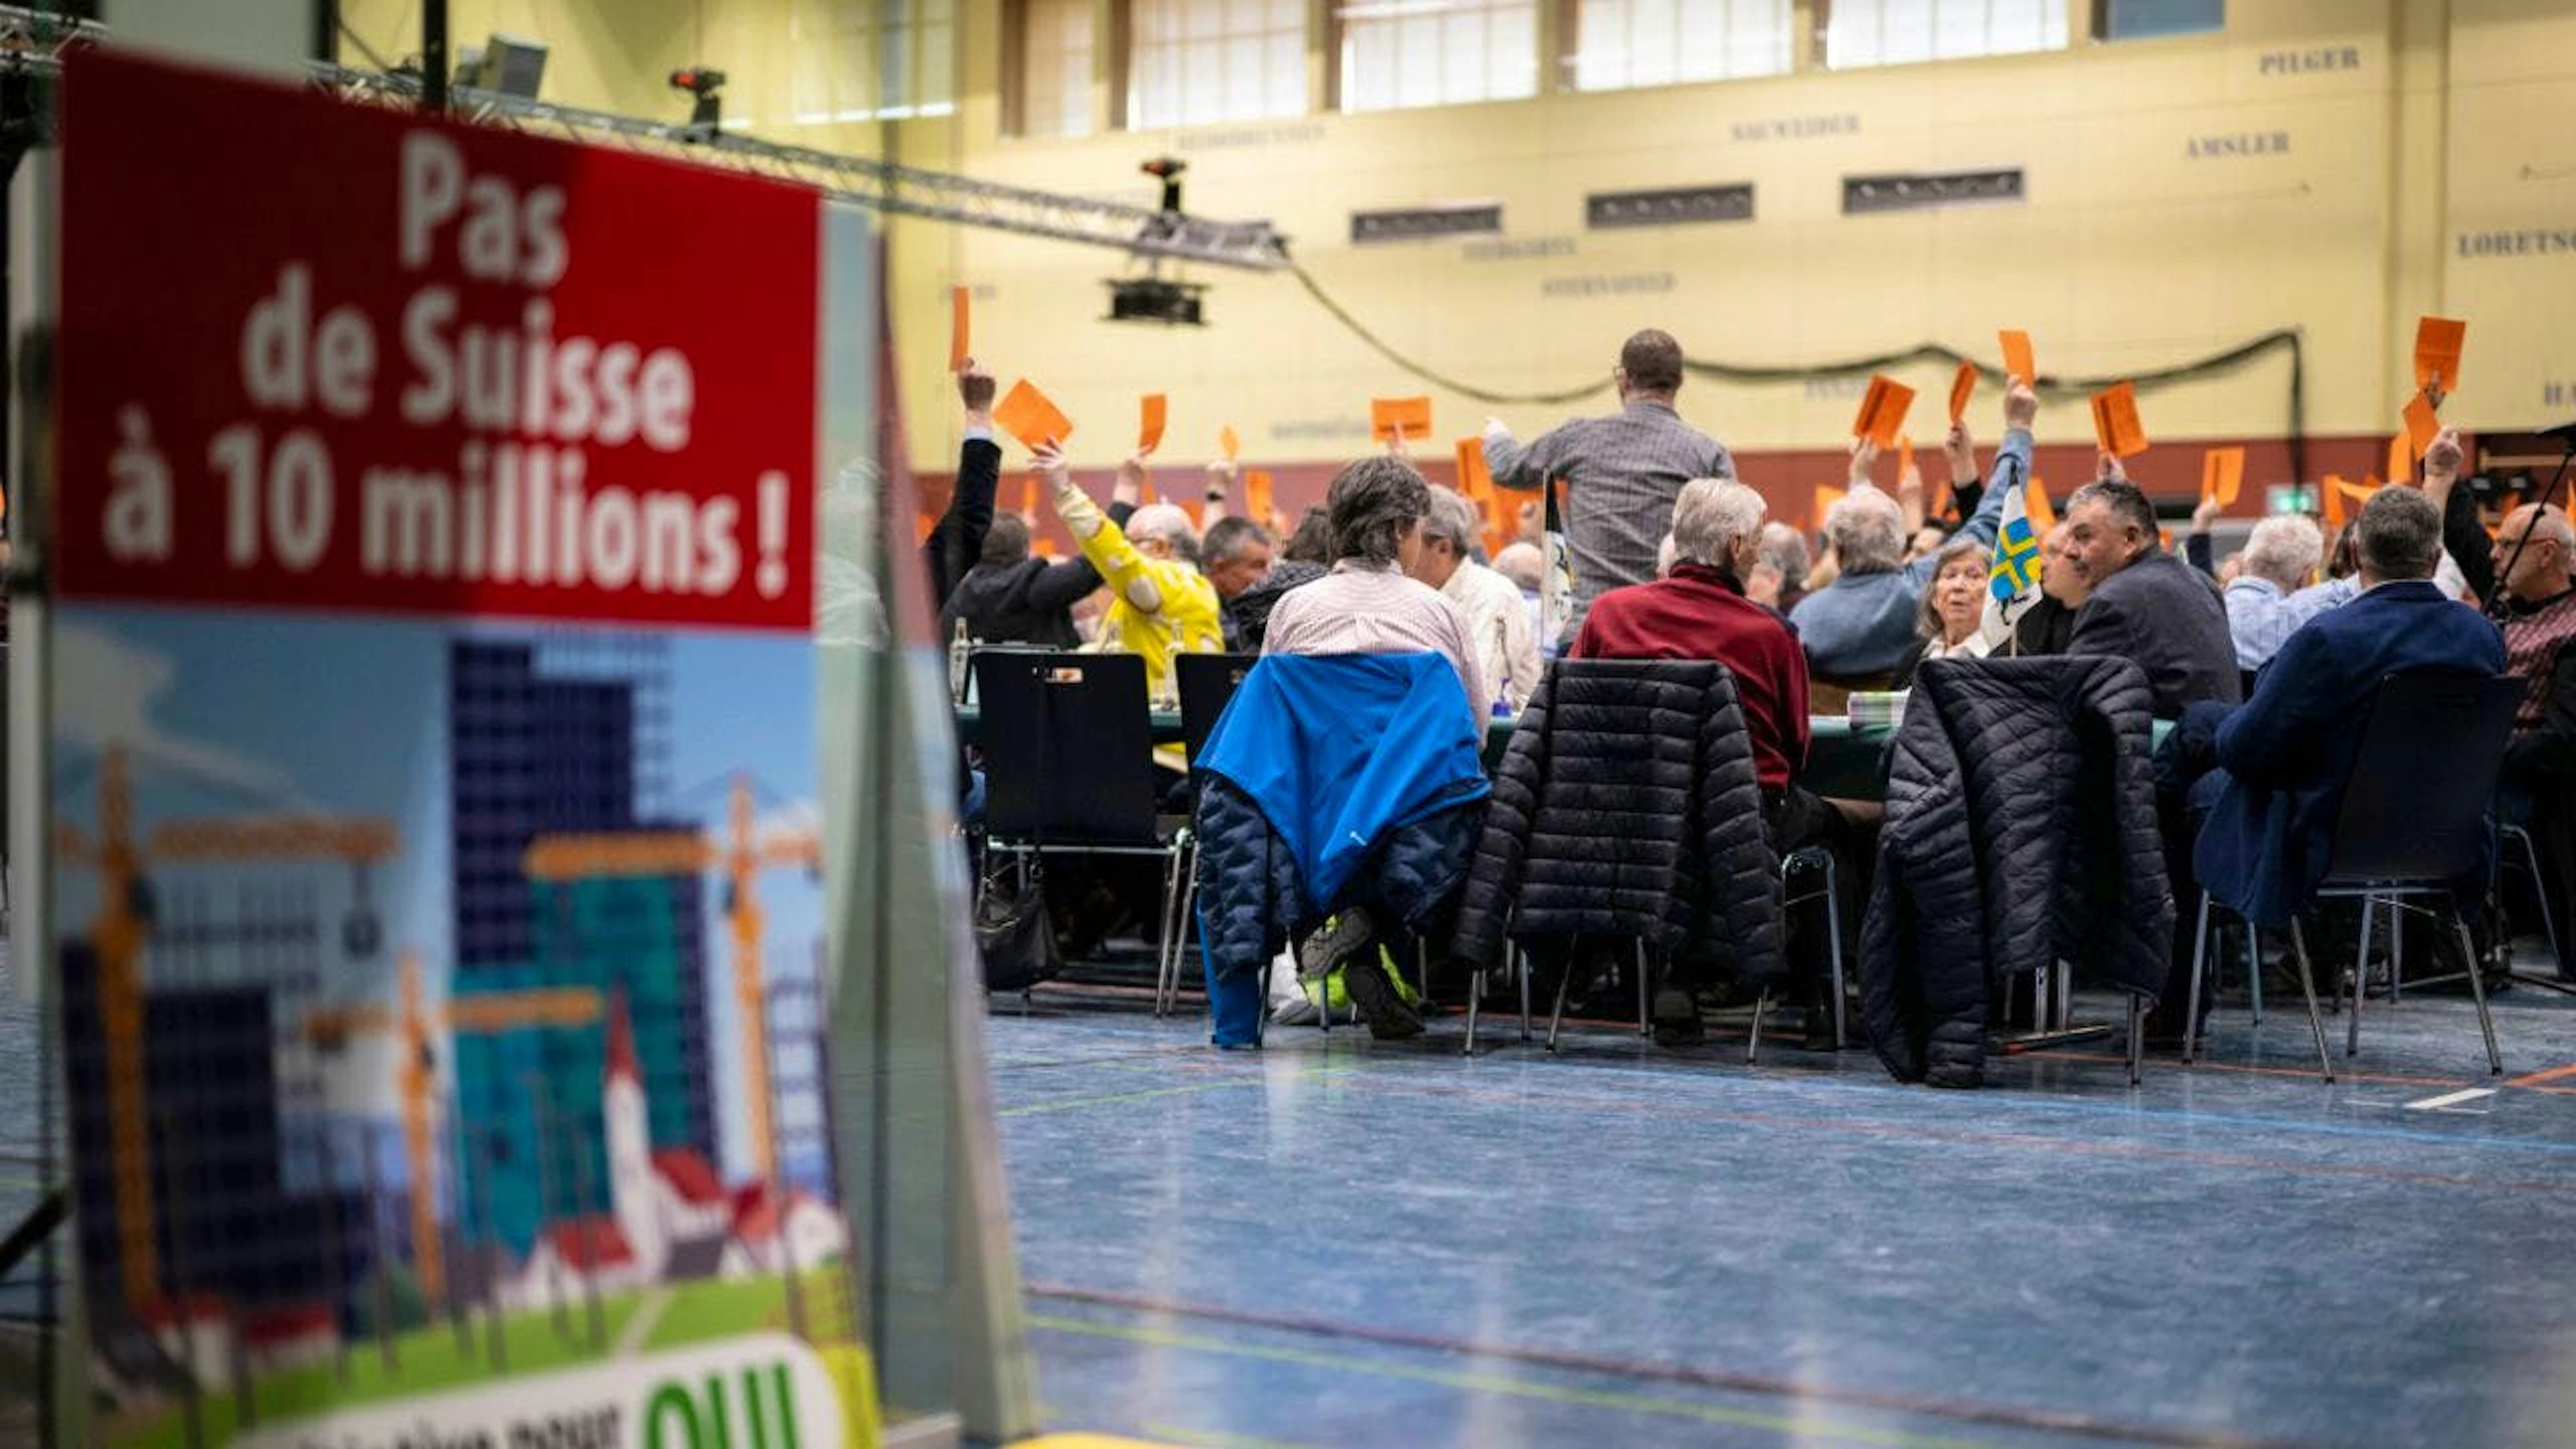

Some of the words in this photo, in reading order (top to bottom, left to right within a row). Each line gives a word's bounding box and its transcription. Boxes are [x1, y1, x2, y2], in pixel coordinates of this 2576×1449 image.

[2259, 46, 2361, 76] PILGER
[402, 131, 568, 286] Pas
[2187, 130, 2291, 160] AMSLER
[243, 266, 376, 415] de
[404, 287, 695, 451] Suisse
[105, 404, 172, 559] à
[211, 427, 334, 568] 10
